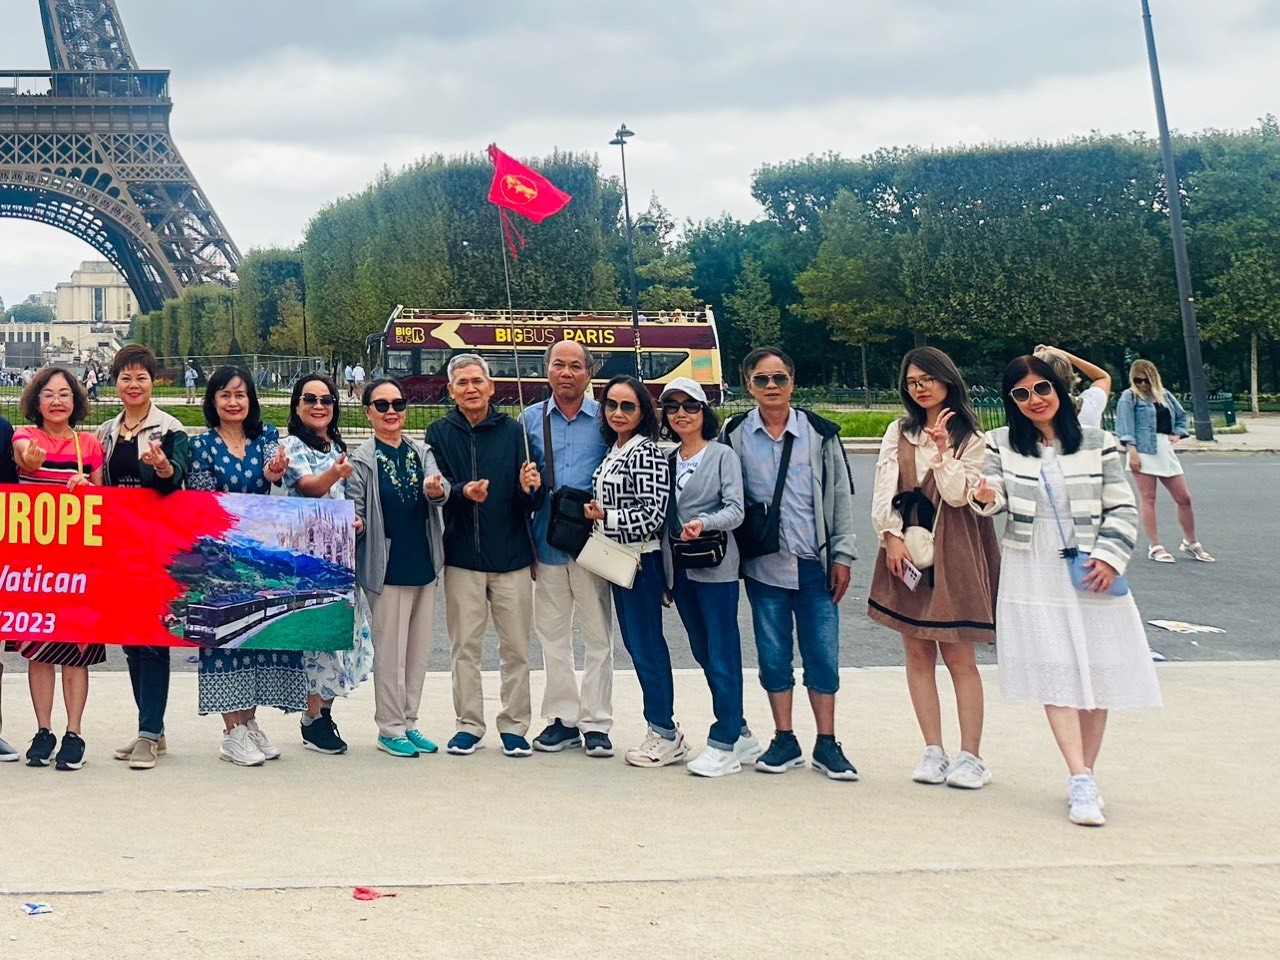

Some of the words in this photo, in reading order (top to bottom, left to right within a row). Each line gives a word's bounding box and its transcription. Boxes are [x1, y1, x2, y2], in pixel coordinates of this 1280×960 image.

[395, 327, 412, 336] BIG
[395, 336, 412, 344] BUS
[563, 329, 615, 344] PARIS
